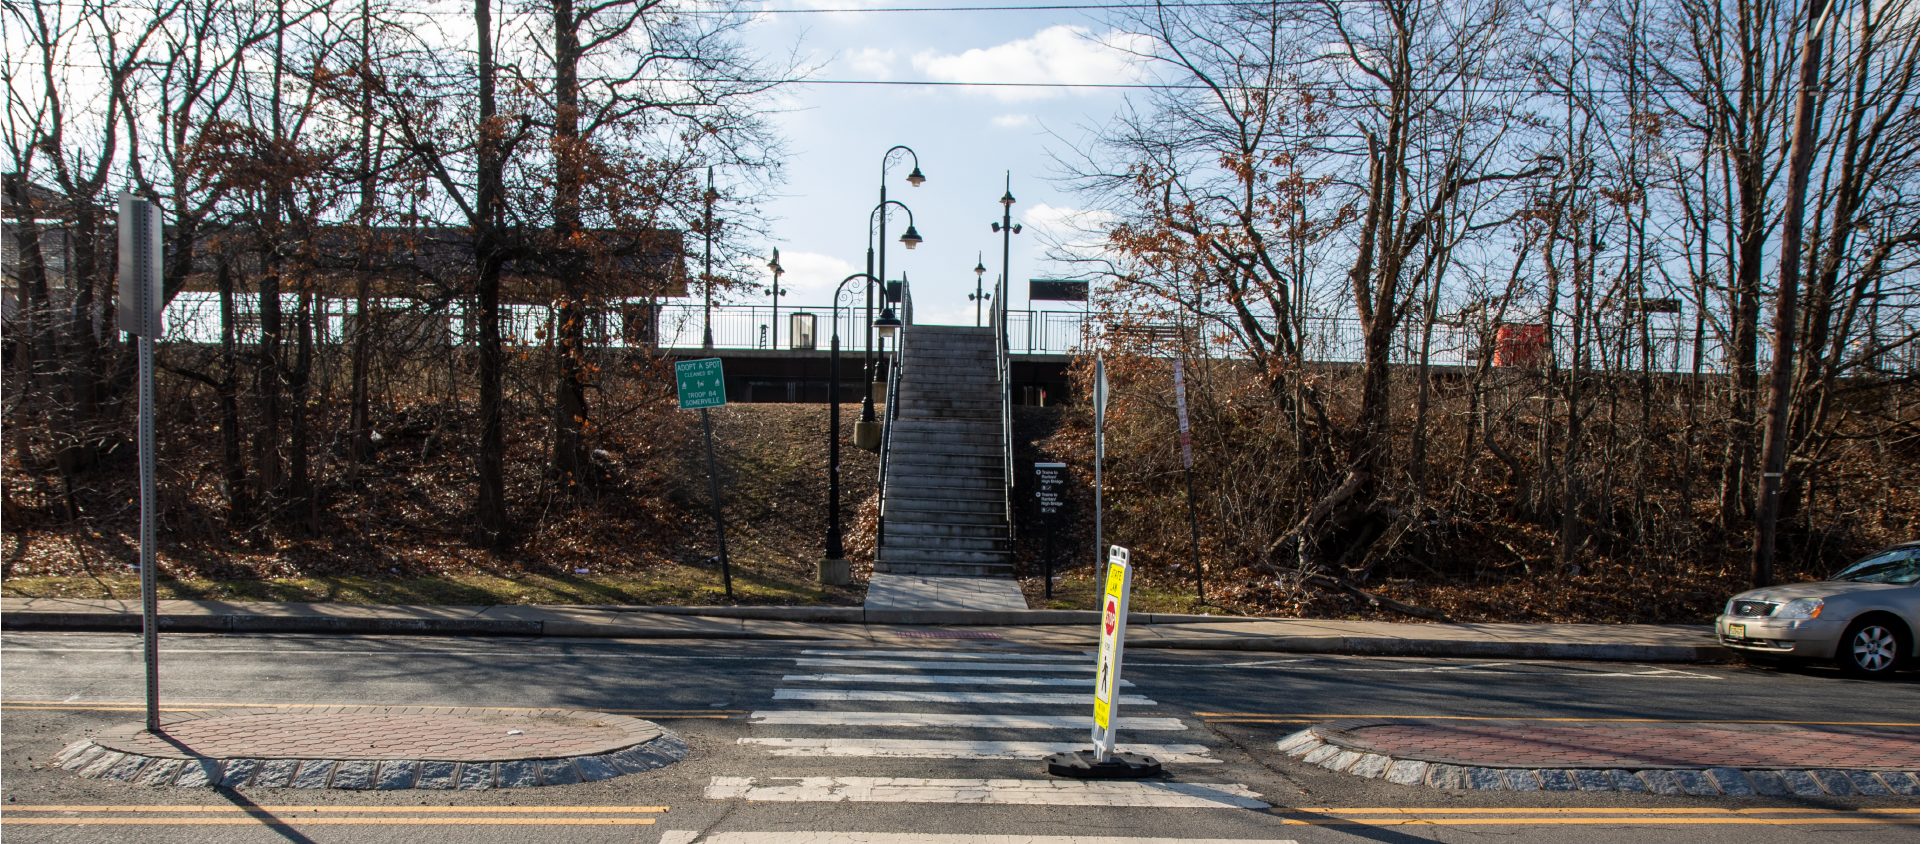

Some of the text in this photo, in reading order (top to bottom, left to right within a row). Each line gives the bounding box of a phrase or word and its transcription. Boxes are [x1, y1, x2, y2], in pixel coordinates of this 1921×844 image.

[678, 363, 696, 371] ADOPT
[705, 361, 720, 369] SPOT
[685, 397, 720, 406] SOMERVILLE
[1110, 568, 1123, 582] STATE
[1105, 610, 1116, 627] STOP
